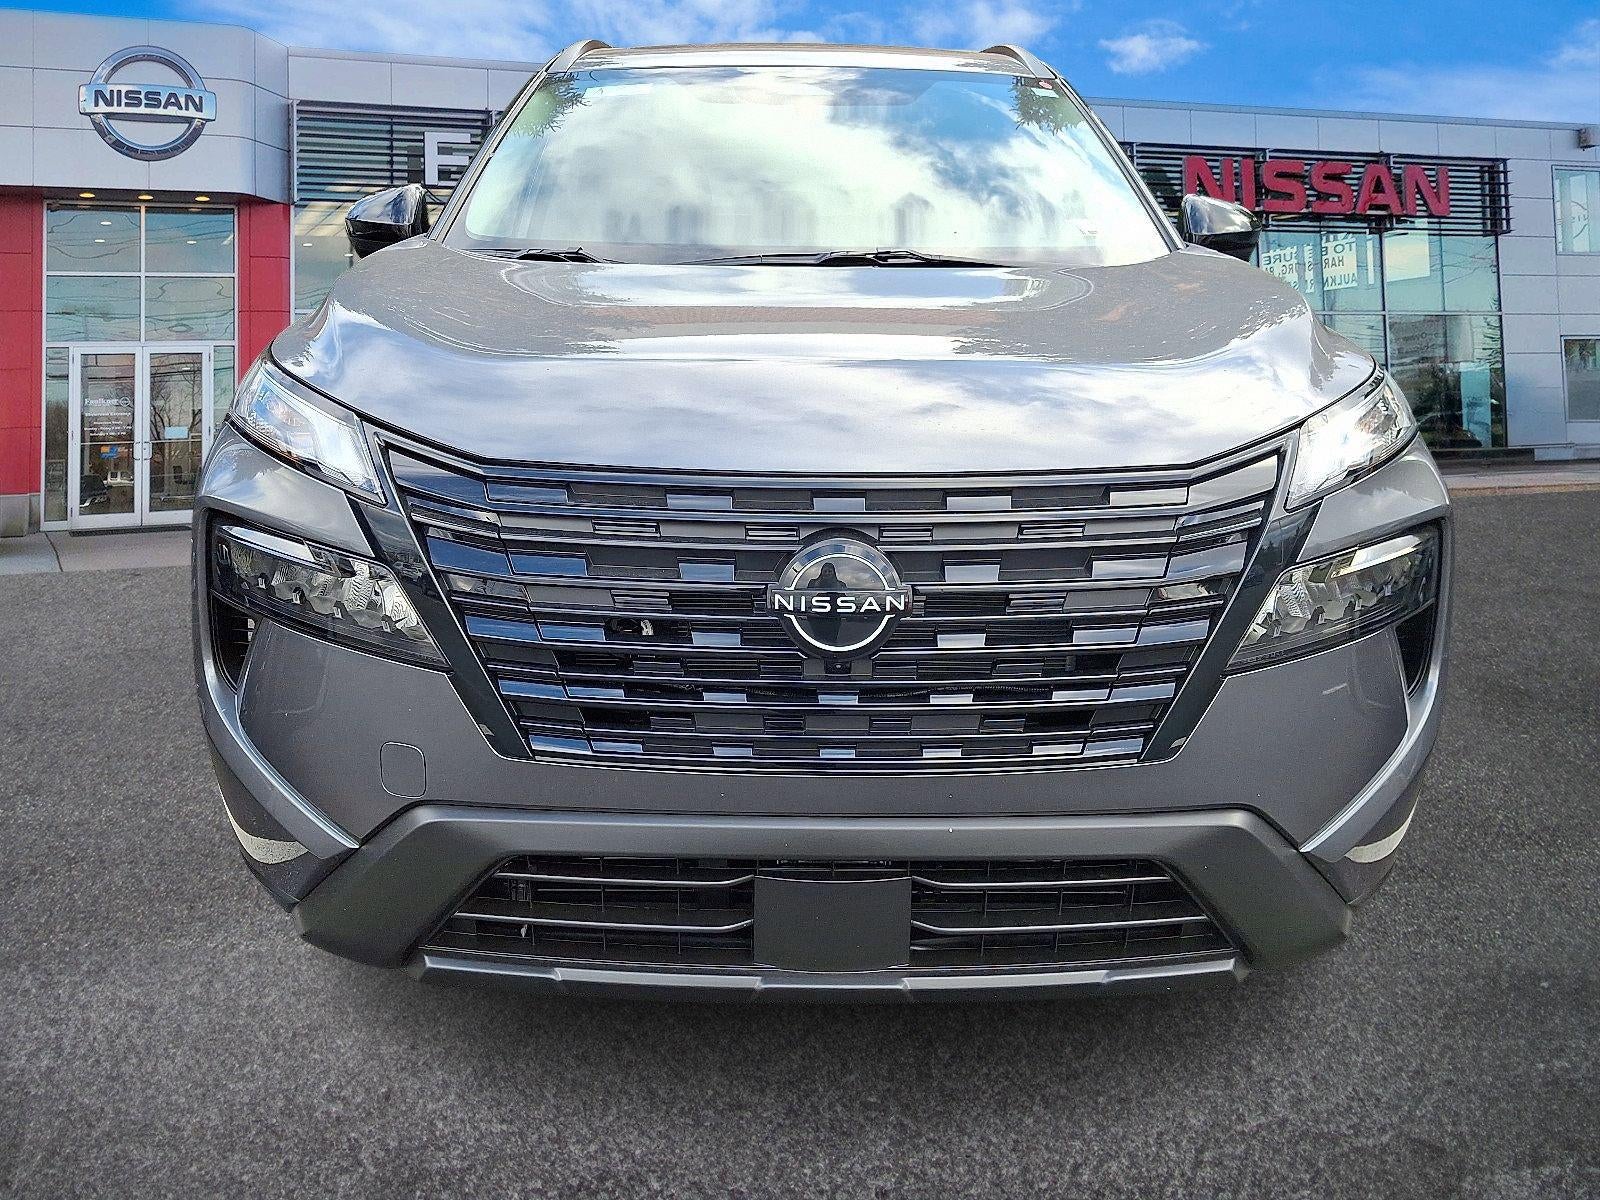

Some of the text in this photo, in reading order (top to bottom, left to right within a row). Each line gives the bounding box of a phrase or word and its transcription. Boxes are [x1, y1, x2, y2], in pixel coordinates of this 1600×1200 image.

[94, 89, 204, 113] NISSAN
[1182, 155, 1451, 216] NISSAN
[774, 593, 905, 613] NISSAN
